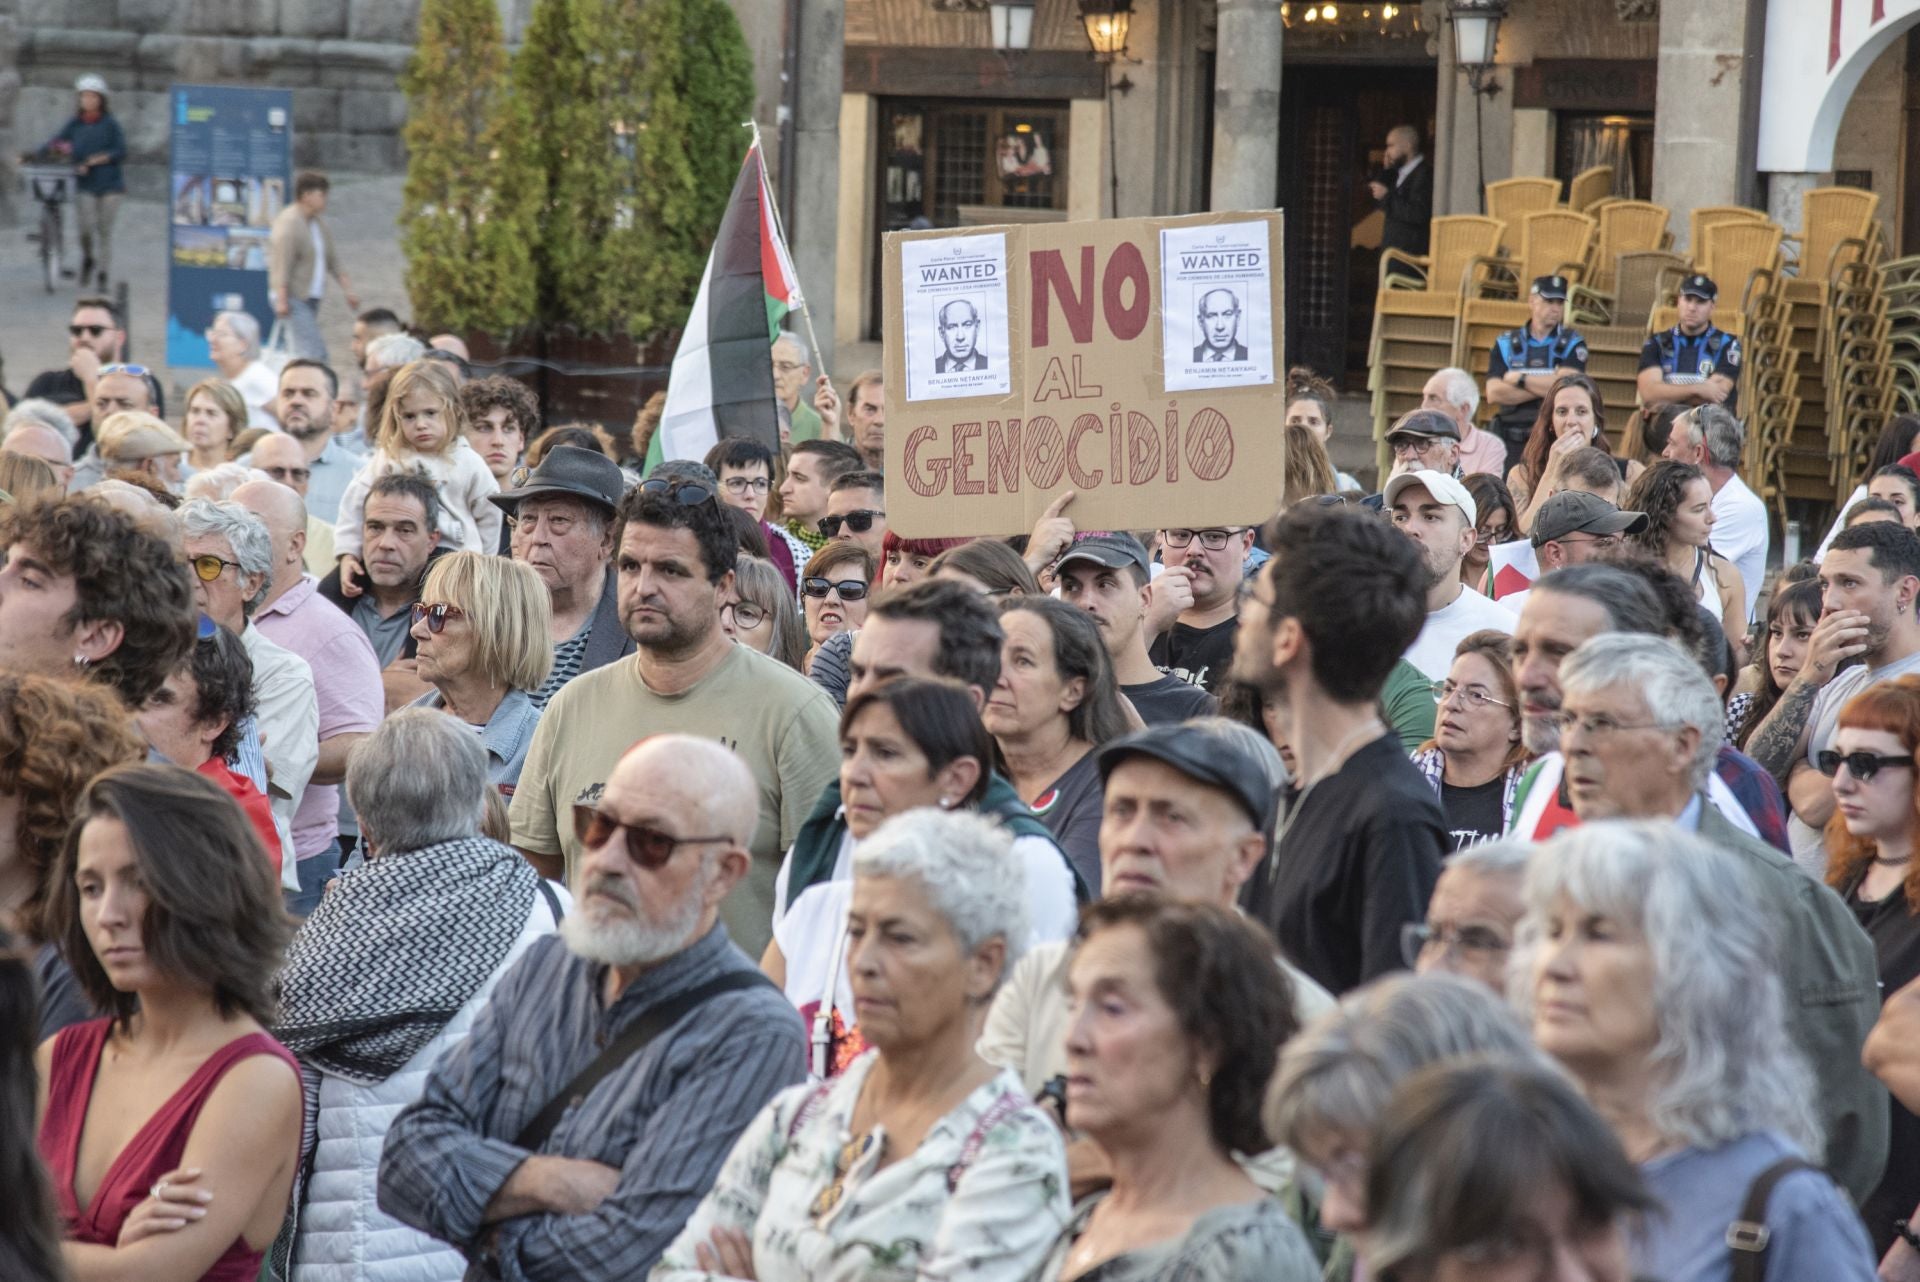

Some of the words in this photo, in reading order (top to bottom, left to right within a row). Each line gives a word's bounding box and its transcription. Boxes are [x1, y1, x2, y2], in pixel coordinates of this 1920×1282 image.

[921, 263, 996, 282] WANTED
[1181, 252, 1260, 269] WANTED
[1029, 241, 1151, 348] NO
[1033, 354, 1103, 402] AL
